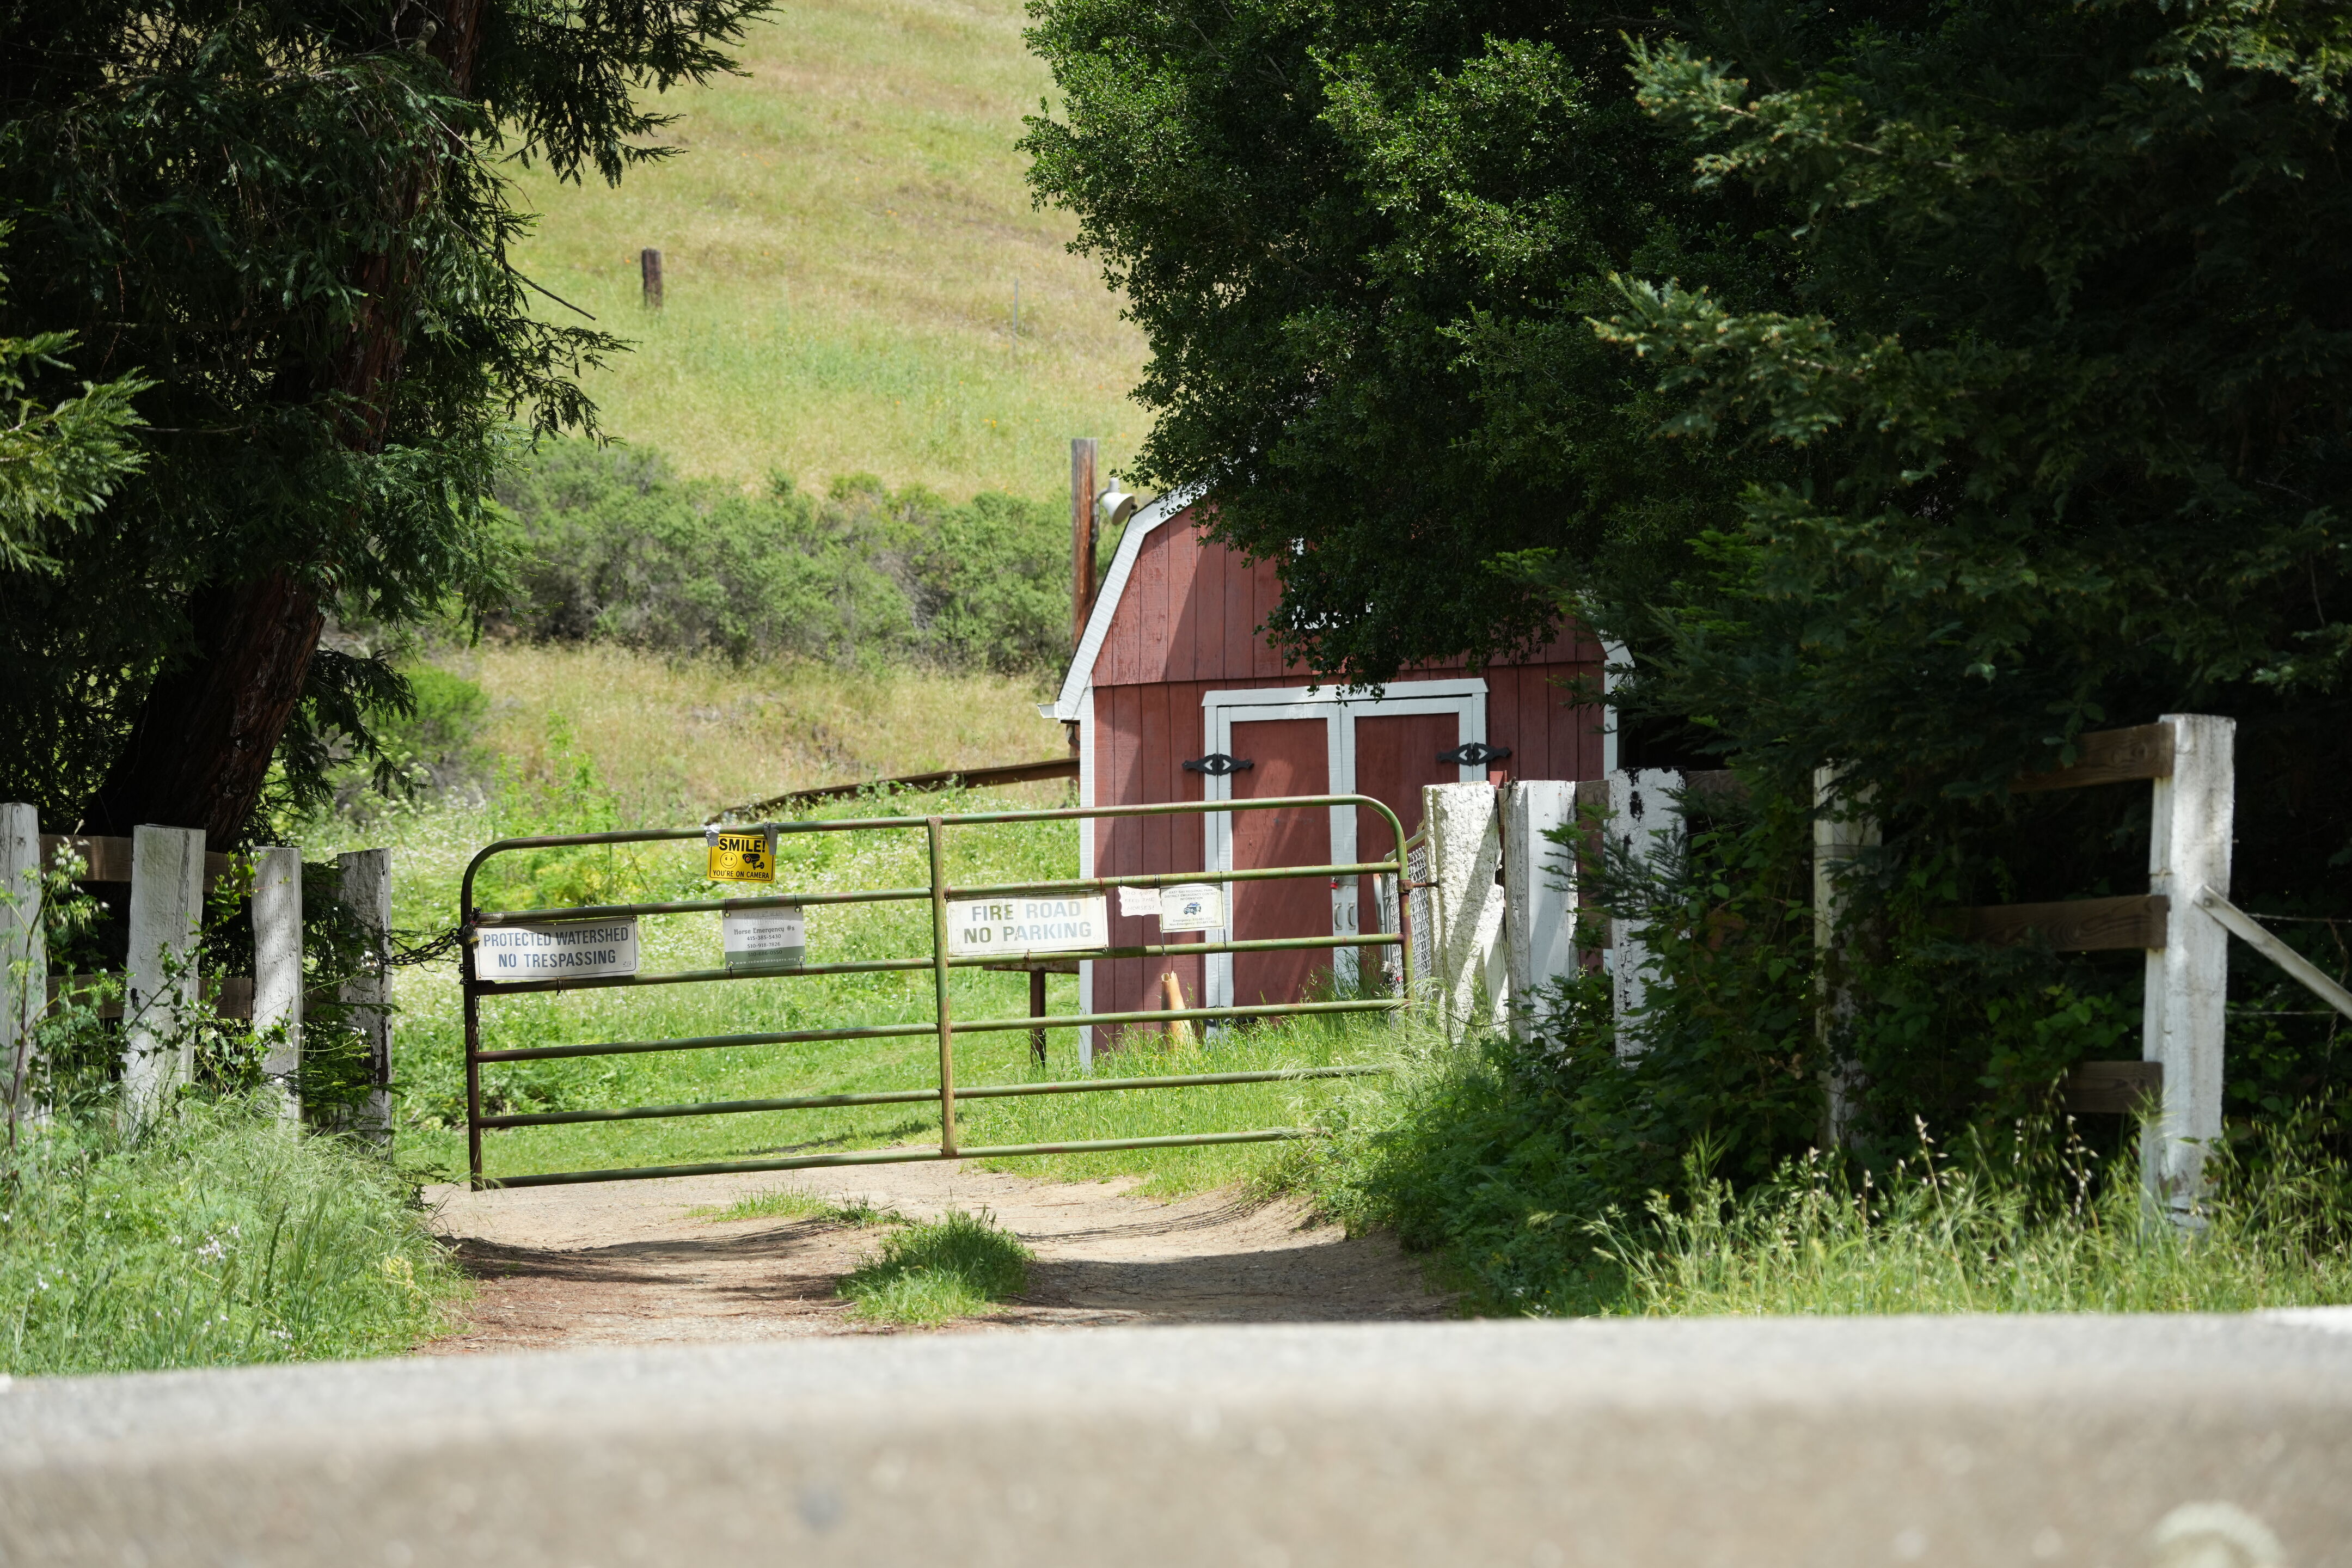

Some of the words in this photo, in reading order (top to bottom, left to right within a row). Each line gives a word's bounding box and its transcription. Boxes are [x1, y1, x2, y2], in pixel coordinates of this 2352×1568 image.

[719, 838, 766, 853] SMILE!
[972, 904, 1013, 921] FIRE
[1026, 901, 1081, 918] ROAD
[484, 932, 551, 947] PROTECTED
[556, 927, 629, 946] WATERSHED
[964, 927, 991, 944] NO
[1003, 922, 1092, 941] PARKING
[499, 954, 517, 967] NO
[524, 950, 616, 967] TRESPASSING
